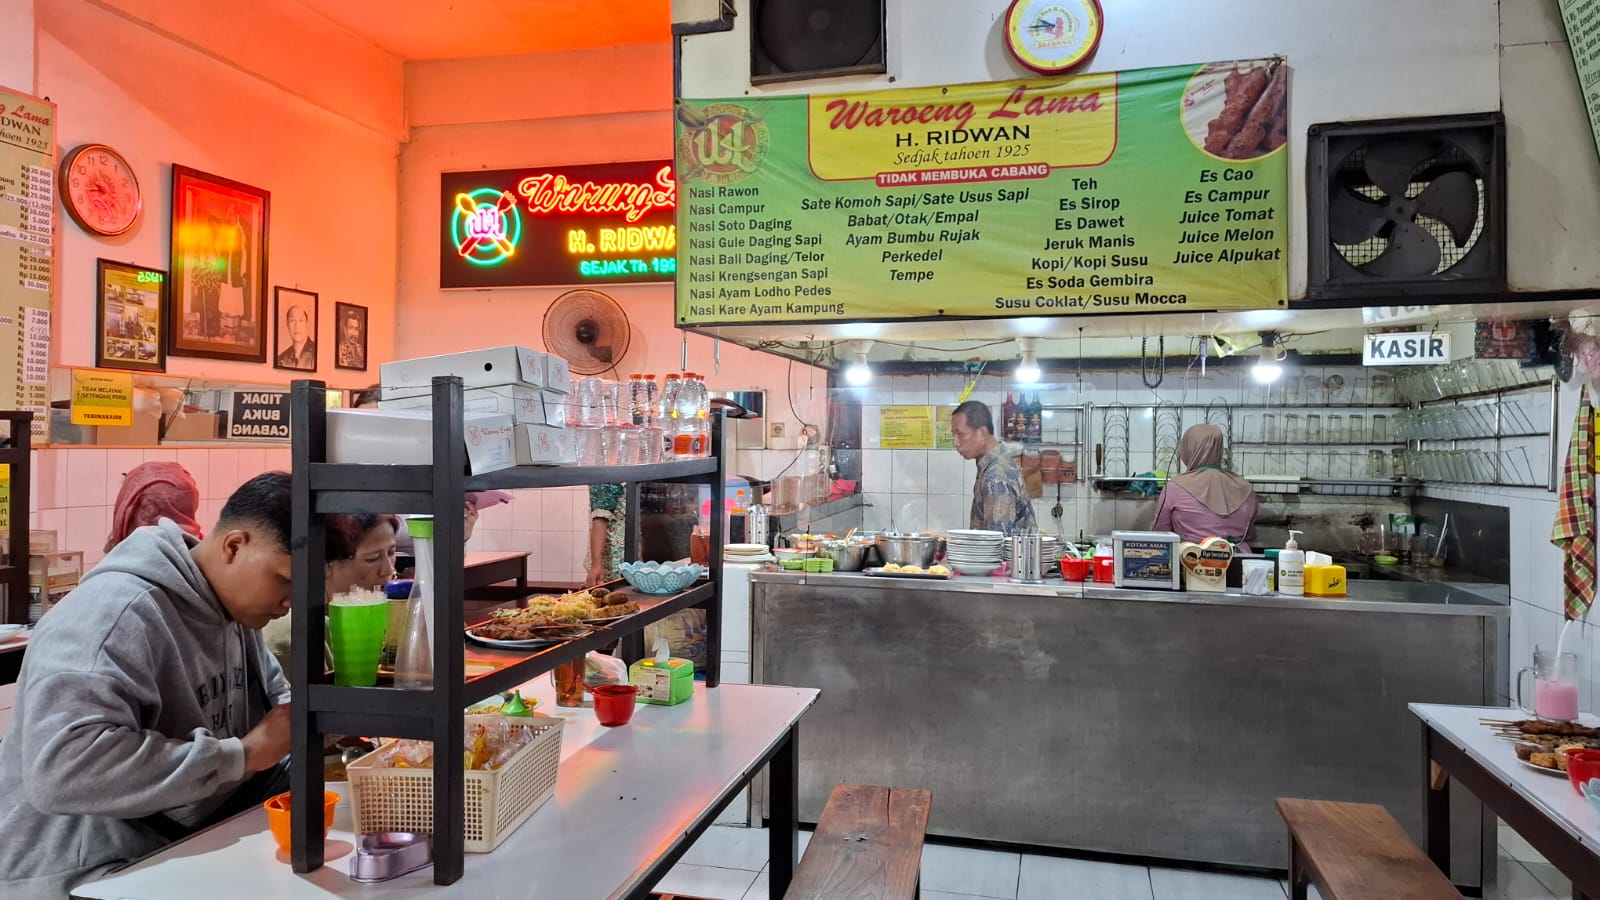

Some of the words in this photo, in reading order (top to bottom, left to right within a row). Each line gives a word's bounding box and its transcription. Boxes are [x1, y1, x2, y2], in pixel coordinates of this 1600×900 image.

[11, 105, 49, 126] Lama
[825, 98, 976, 131] Waroeng
[988, 84, 1103, 119] Lama
[895, 132, 919, 147] H.
[927, 124, 1030, 146] RIDWAN
[99, 154, 108, 166] 12
[894, 148, 943, 167] Sedjak
[944, 145, 991, 162] tahoen
[996, 143, 1031, 158] 1925
[878, 172, 920, 185] TIDAK
[921, 167, 987, 182] MEMBUKA
[990, 164, 1047, 178] CABANG
[1199, 170, 1218, 183] Es
[1223, 168, 1254, 181] Cao
[689, 187, 715, 198] Nasi
[718, 186, 759, 197] Rawon
[1072, 178, 1098, 191] Teh
[801, 197, 831, 210] Sate
[835, 195, 881, 209] Komoh
[885, 191, 954, 209] Sapi/Sate
[959, 190, 993, 204] Usus
[996, 187, 1030, 203] Sapi
[1059, 198, 1077, 211] Es
[1080, 196, 1120, 211] Sirop
[1184, 190, 1203, 204] Es
[1207, 188, 1270, 205] Campur
[689, 204, 715, 216] Nasi
[718, 203, 765, 215] Campur
[1179, 210, 1220, 224] Juice
[1225, 206, 1275, 222] Tomat
[689, 221, 715, 232] Nasi
[718, 220, 746, 231] Soto
[748, 218, 792, 232] Daging
[847, 209, 979, 227] Babat/Otak/Empal
[1055, 217, 1072, 230] Es
[1077, 215, 1125, 229] Dawet
[568, 229, 595, 253] H.
[689, 238, 715, 249] Nasi
[718, 236, 745, 248] Gule
[748, 235, 792, 249] Daging
[794, 233, 822, 247] Sapi
[845, 232, 883, 248] Ayam
[886, 230, 935, 244] Bumbu
[939, 228, 981, 243] Rujak
[1043, 236, 1084, 251] Jeruk
[1088, 234, 1135, 248] Manis
[1178, 230, 1219, 244] Juice
[1224, 228, 1274, 242] Melon
[689, 255, 715, 266] Nasi
[718, 254, 742, 265] Bali
[745, 251, 825, 266] Daging/Telor
[881, 248, 942, 263] Perkedel
[1031, 255, 1106, 271] Kopi/Kopi
[1110, 254, 1148, 267] Susu
[1172, 250, 1214, 264] Juice
[1217, 247, 1281, 264] Alpukat
[579, 259, 629, 275] SEJAK
[628, 259, 648, 273] Th
[689, 271, 715, 283] Nasi
[718, 269, 798, 283] Krengsengan
[800, 267, 828, 281] Sapi
[889, 268, 934, 283] Tempe
[1026, 276, 1043, 290] Es
[1047, 275, 1085, 289] Soda
[1089, 273, 1154, 288] Gembira
[689, 288, 715, 299] Nasi
[718, 287, 751, 300] Ayam
[754, 286, 791, 298] Lodho
[794, 284, 832, 297] Pedes
[689, 305, 715, 316] Nasi
[718, 304, 746, 315] Kare
[749, 303, 782, 316] Ayam
[786, 302, 845, 315] Kampung
[994, 296, 1031, 309] Susu
[1034, 293, 1130, 310] Coklat/Susu
[1134, 292, 1187, 306] Mocca
[1370, 338, 1444, 358] KASIR
